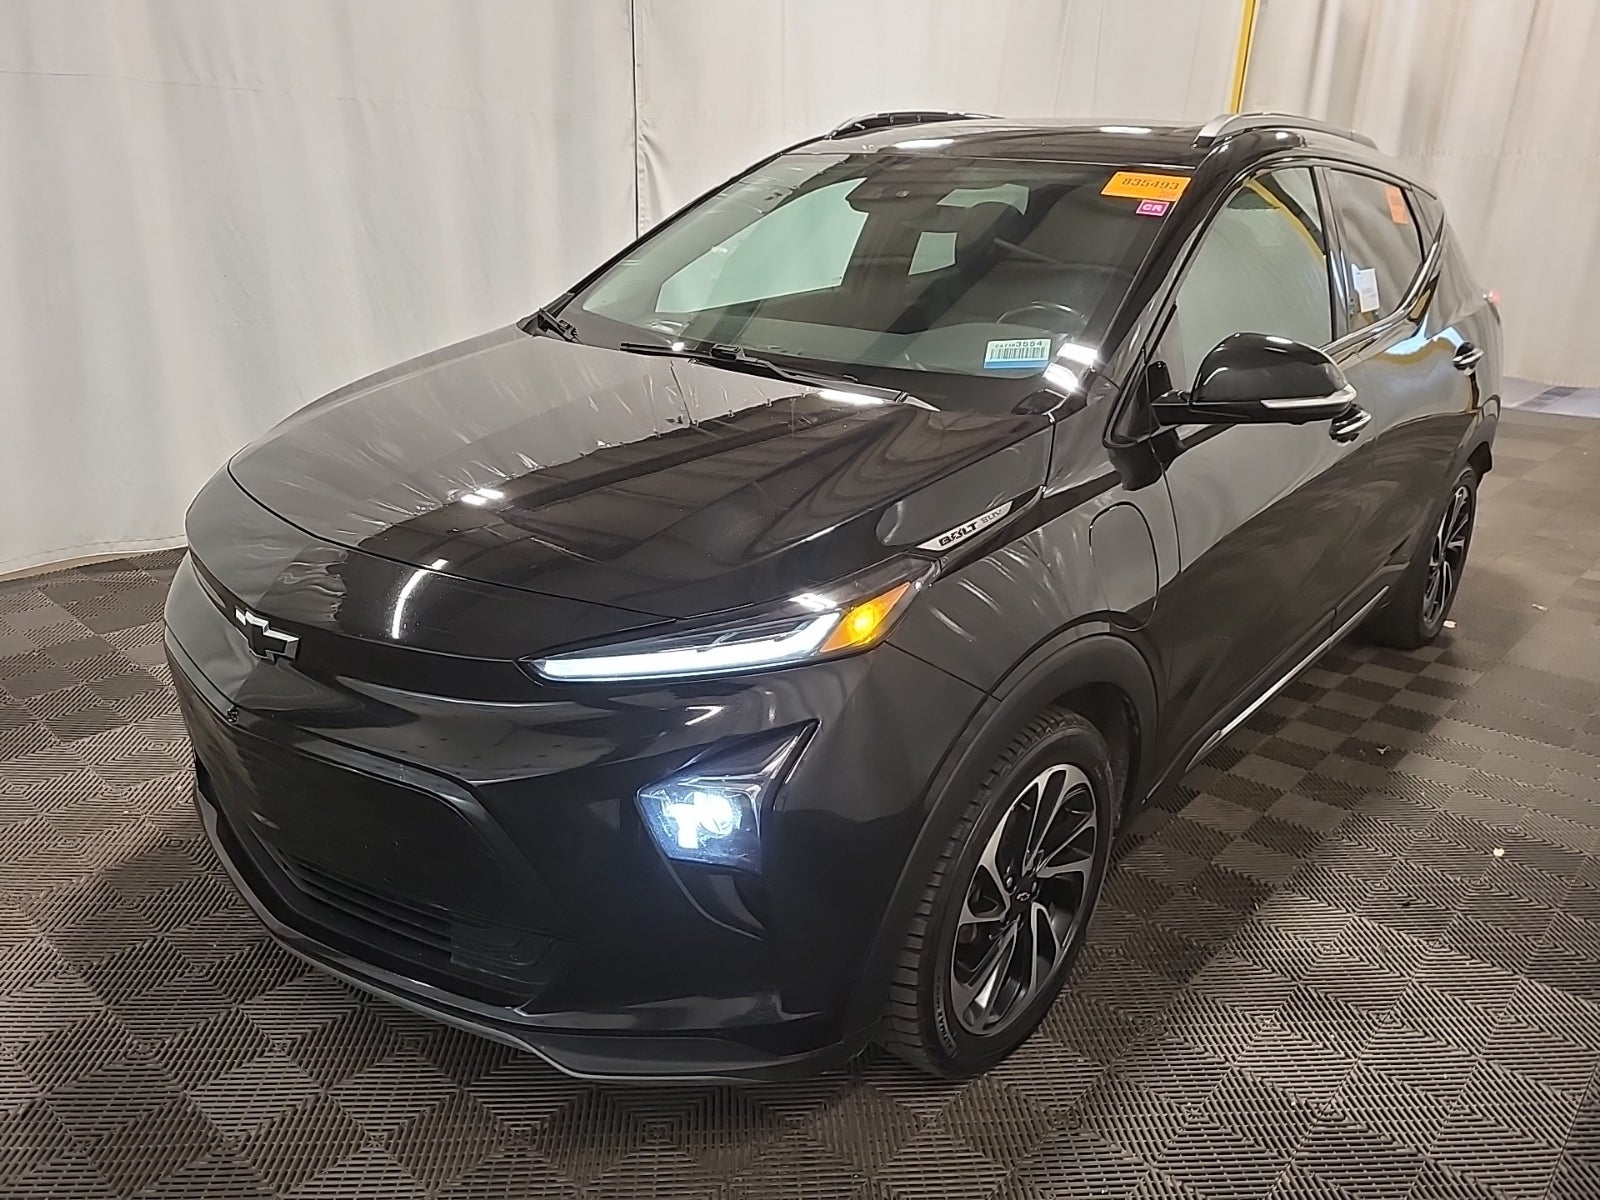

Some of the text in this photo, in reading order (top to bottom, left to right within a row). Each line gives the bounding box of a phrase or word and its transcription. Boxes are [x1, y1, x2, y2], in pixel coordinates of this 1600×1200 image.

[1122, 178, 1179, 190] 835493
[1142, 203, 1163, 212] CR
[938, 521, 978, 547] BOLT
